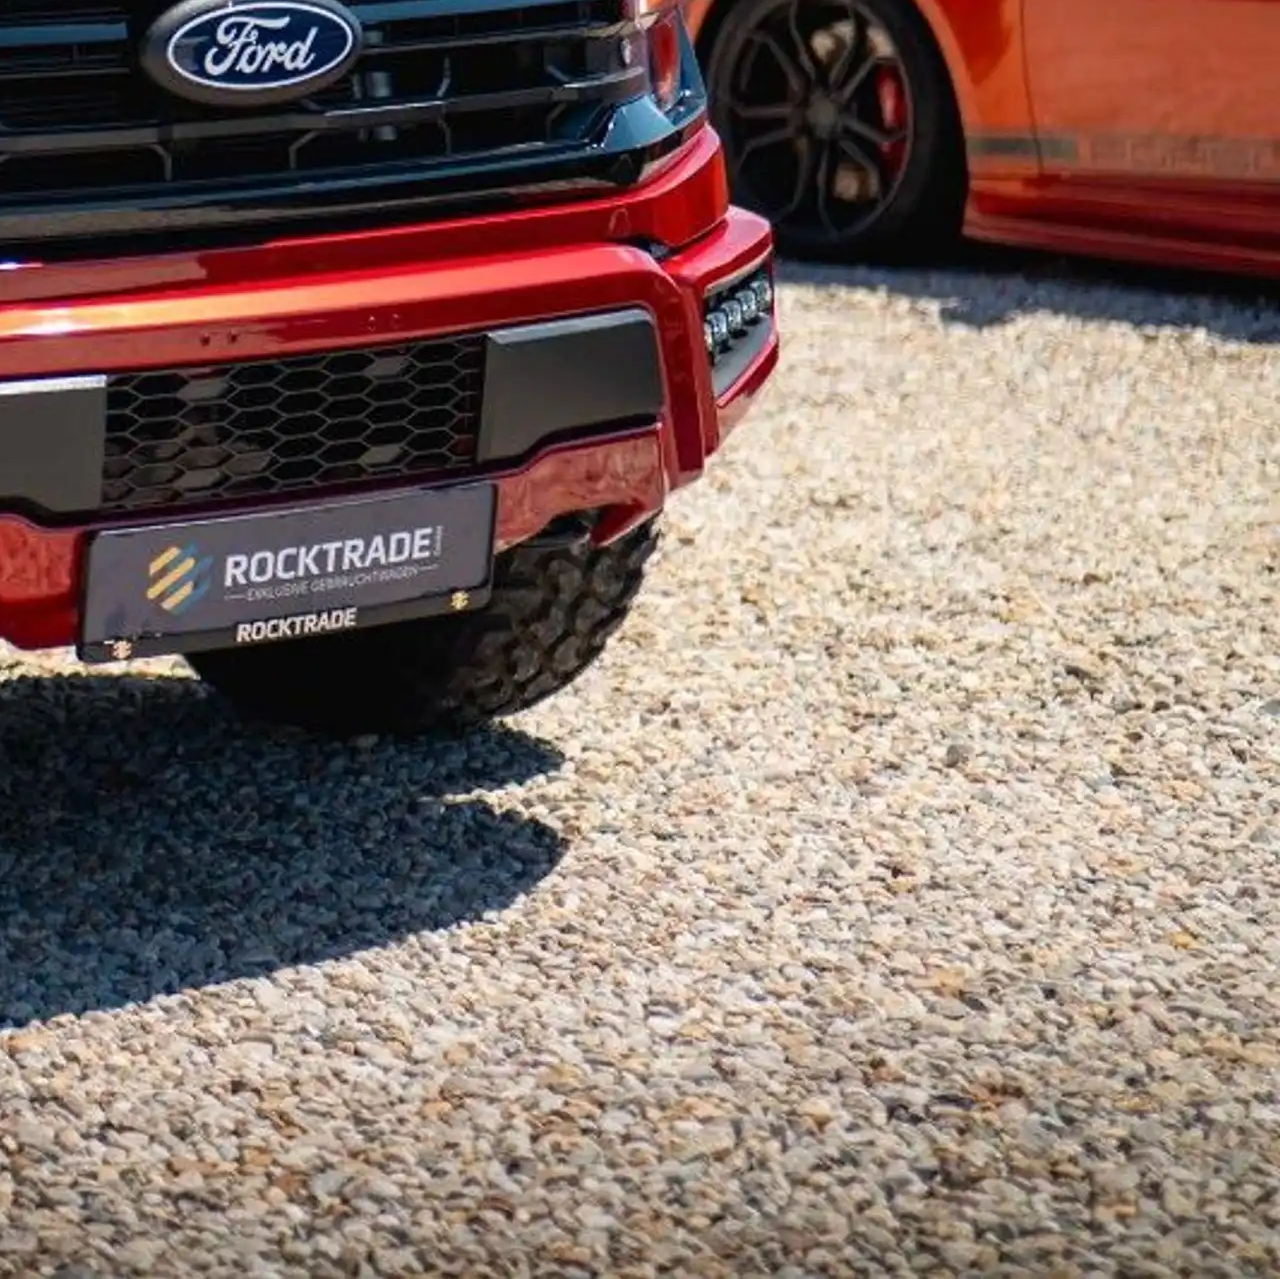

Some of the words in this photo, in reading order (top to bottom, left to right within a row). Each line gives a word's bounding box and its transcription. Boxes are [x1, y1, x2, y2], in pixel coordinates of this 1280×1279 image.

[203, 15, 320, 76] Ford
[223, 526, 433, 587] ROCKTRADE
[236, 607, 358, 642] ROCKTRADE
